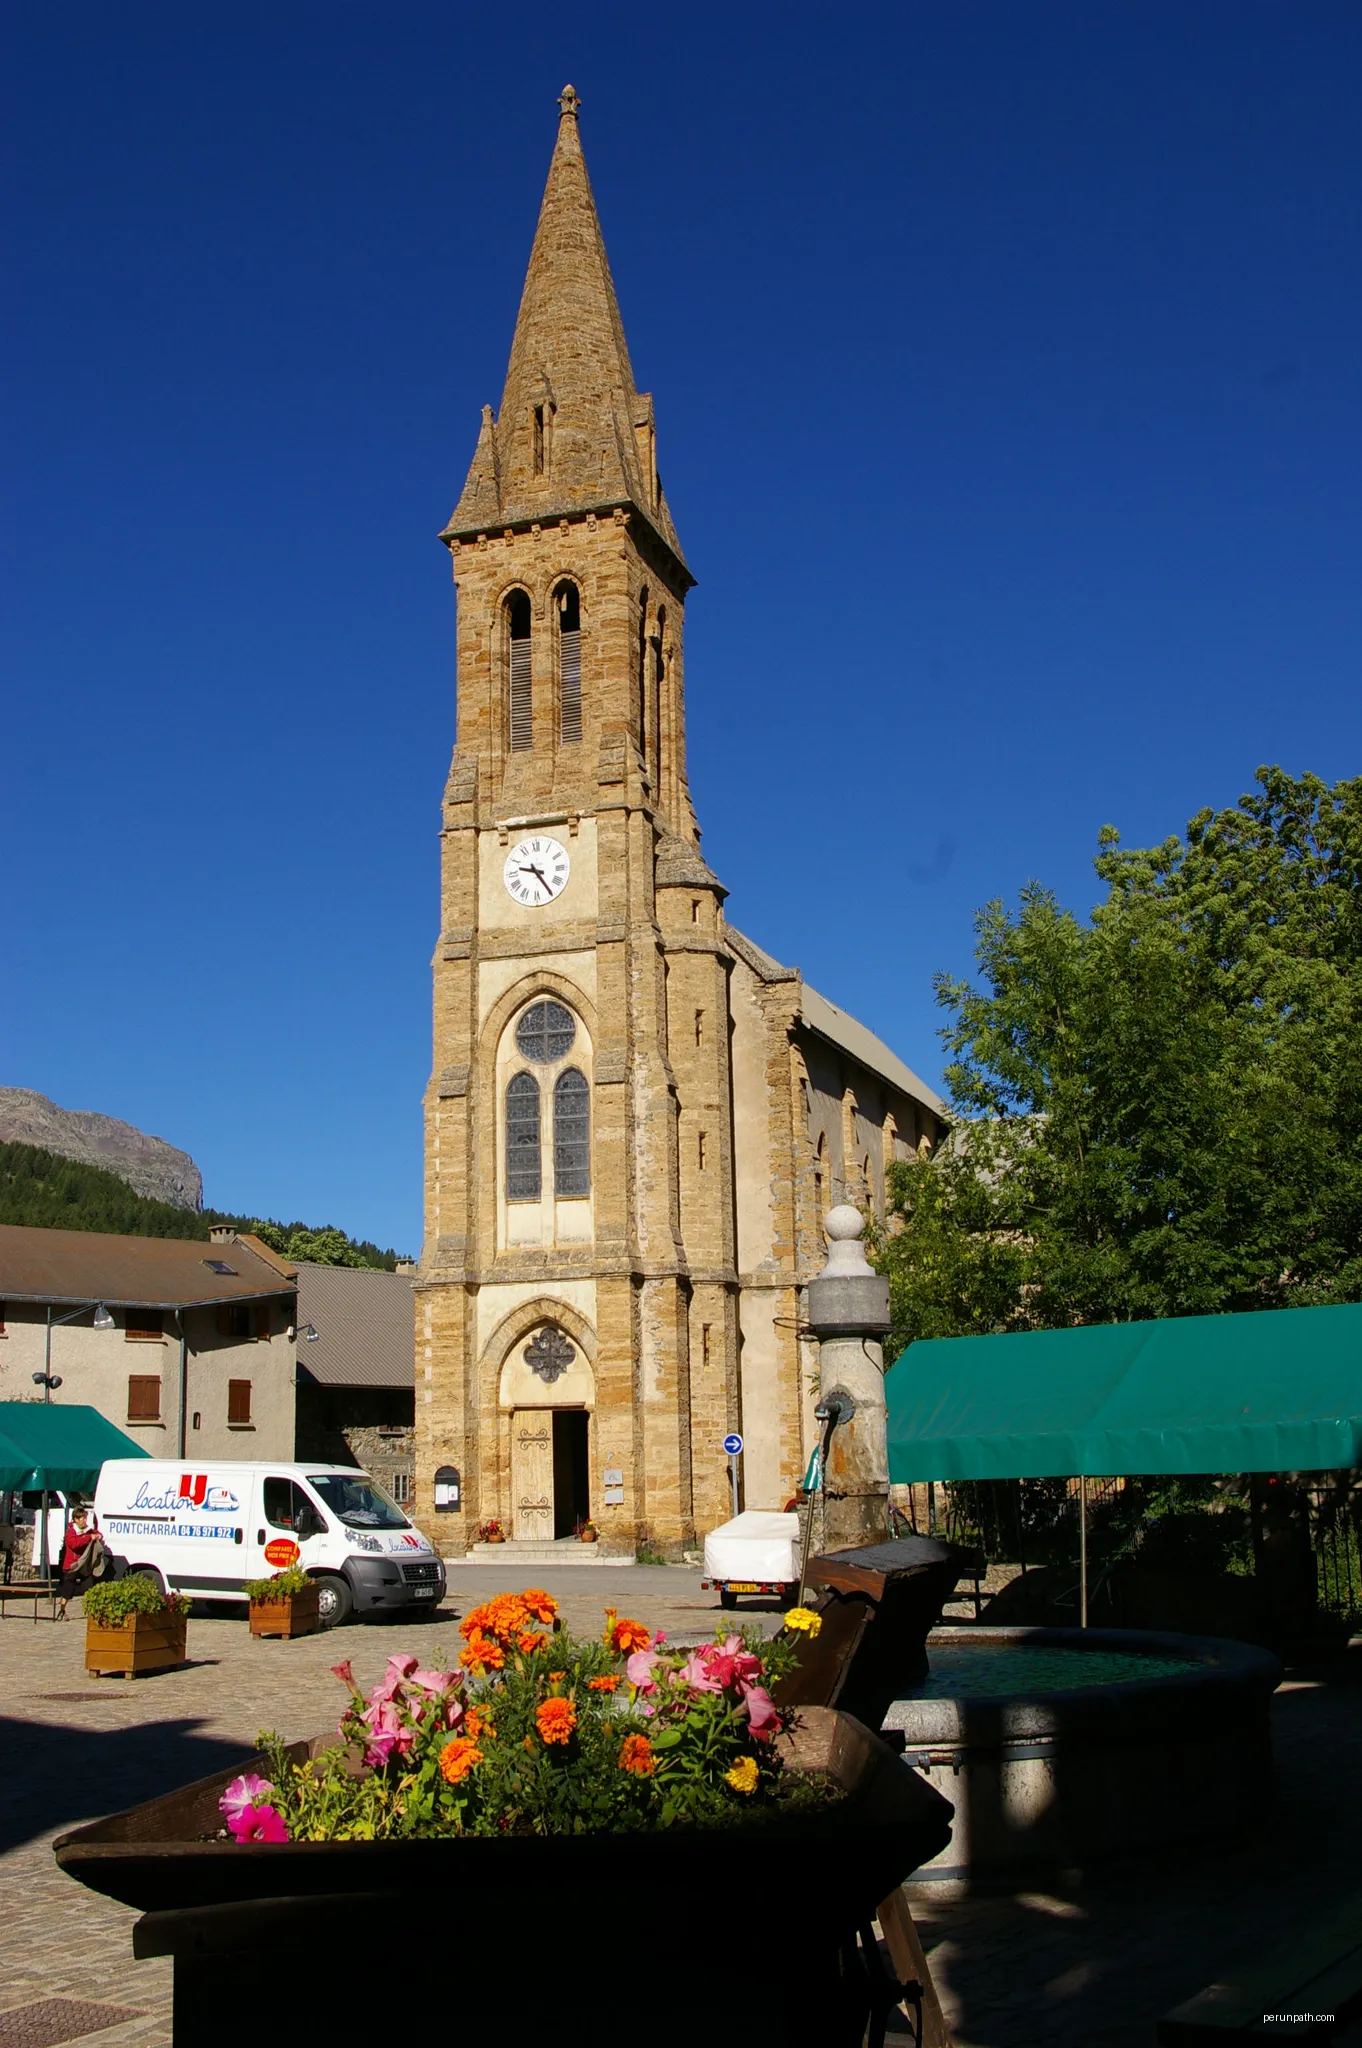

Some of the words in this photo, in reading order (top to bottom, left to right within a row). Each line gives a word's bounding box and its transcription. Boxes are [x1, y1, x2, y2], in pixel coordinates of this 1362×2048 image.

[127, 1481, 199, 1511] location
[179, 1474, 208, 1506] U
[109, 1521, 178, 1536] PONTCHARRA
[181, 1526, 191, 1535] 04
[192, 1526, 201, 1536] 76
[202, 1526, 216, 1537] 971
[217, 1527, 231, 1538] 972
